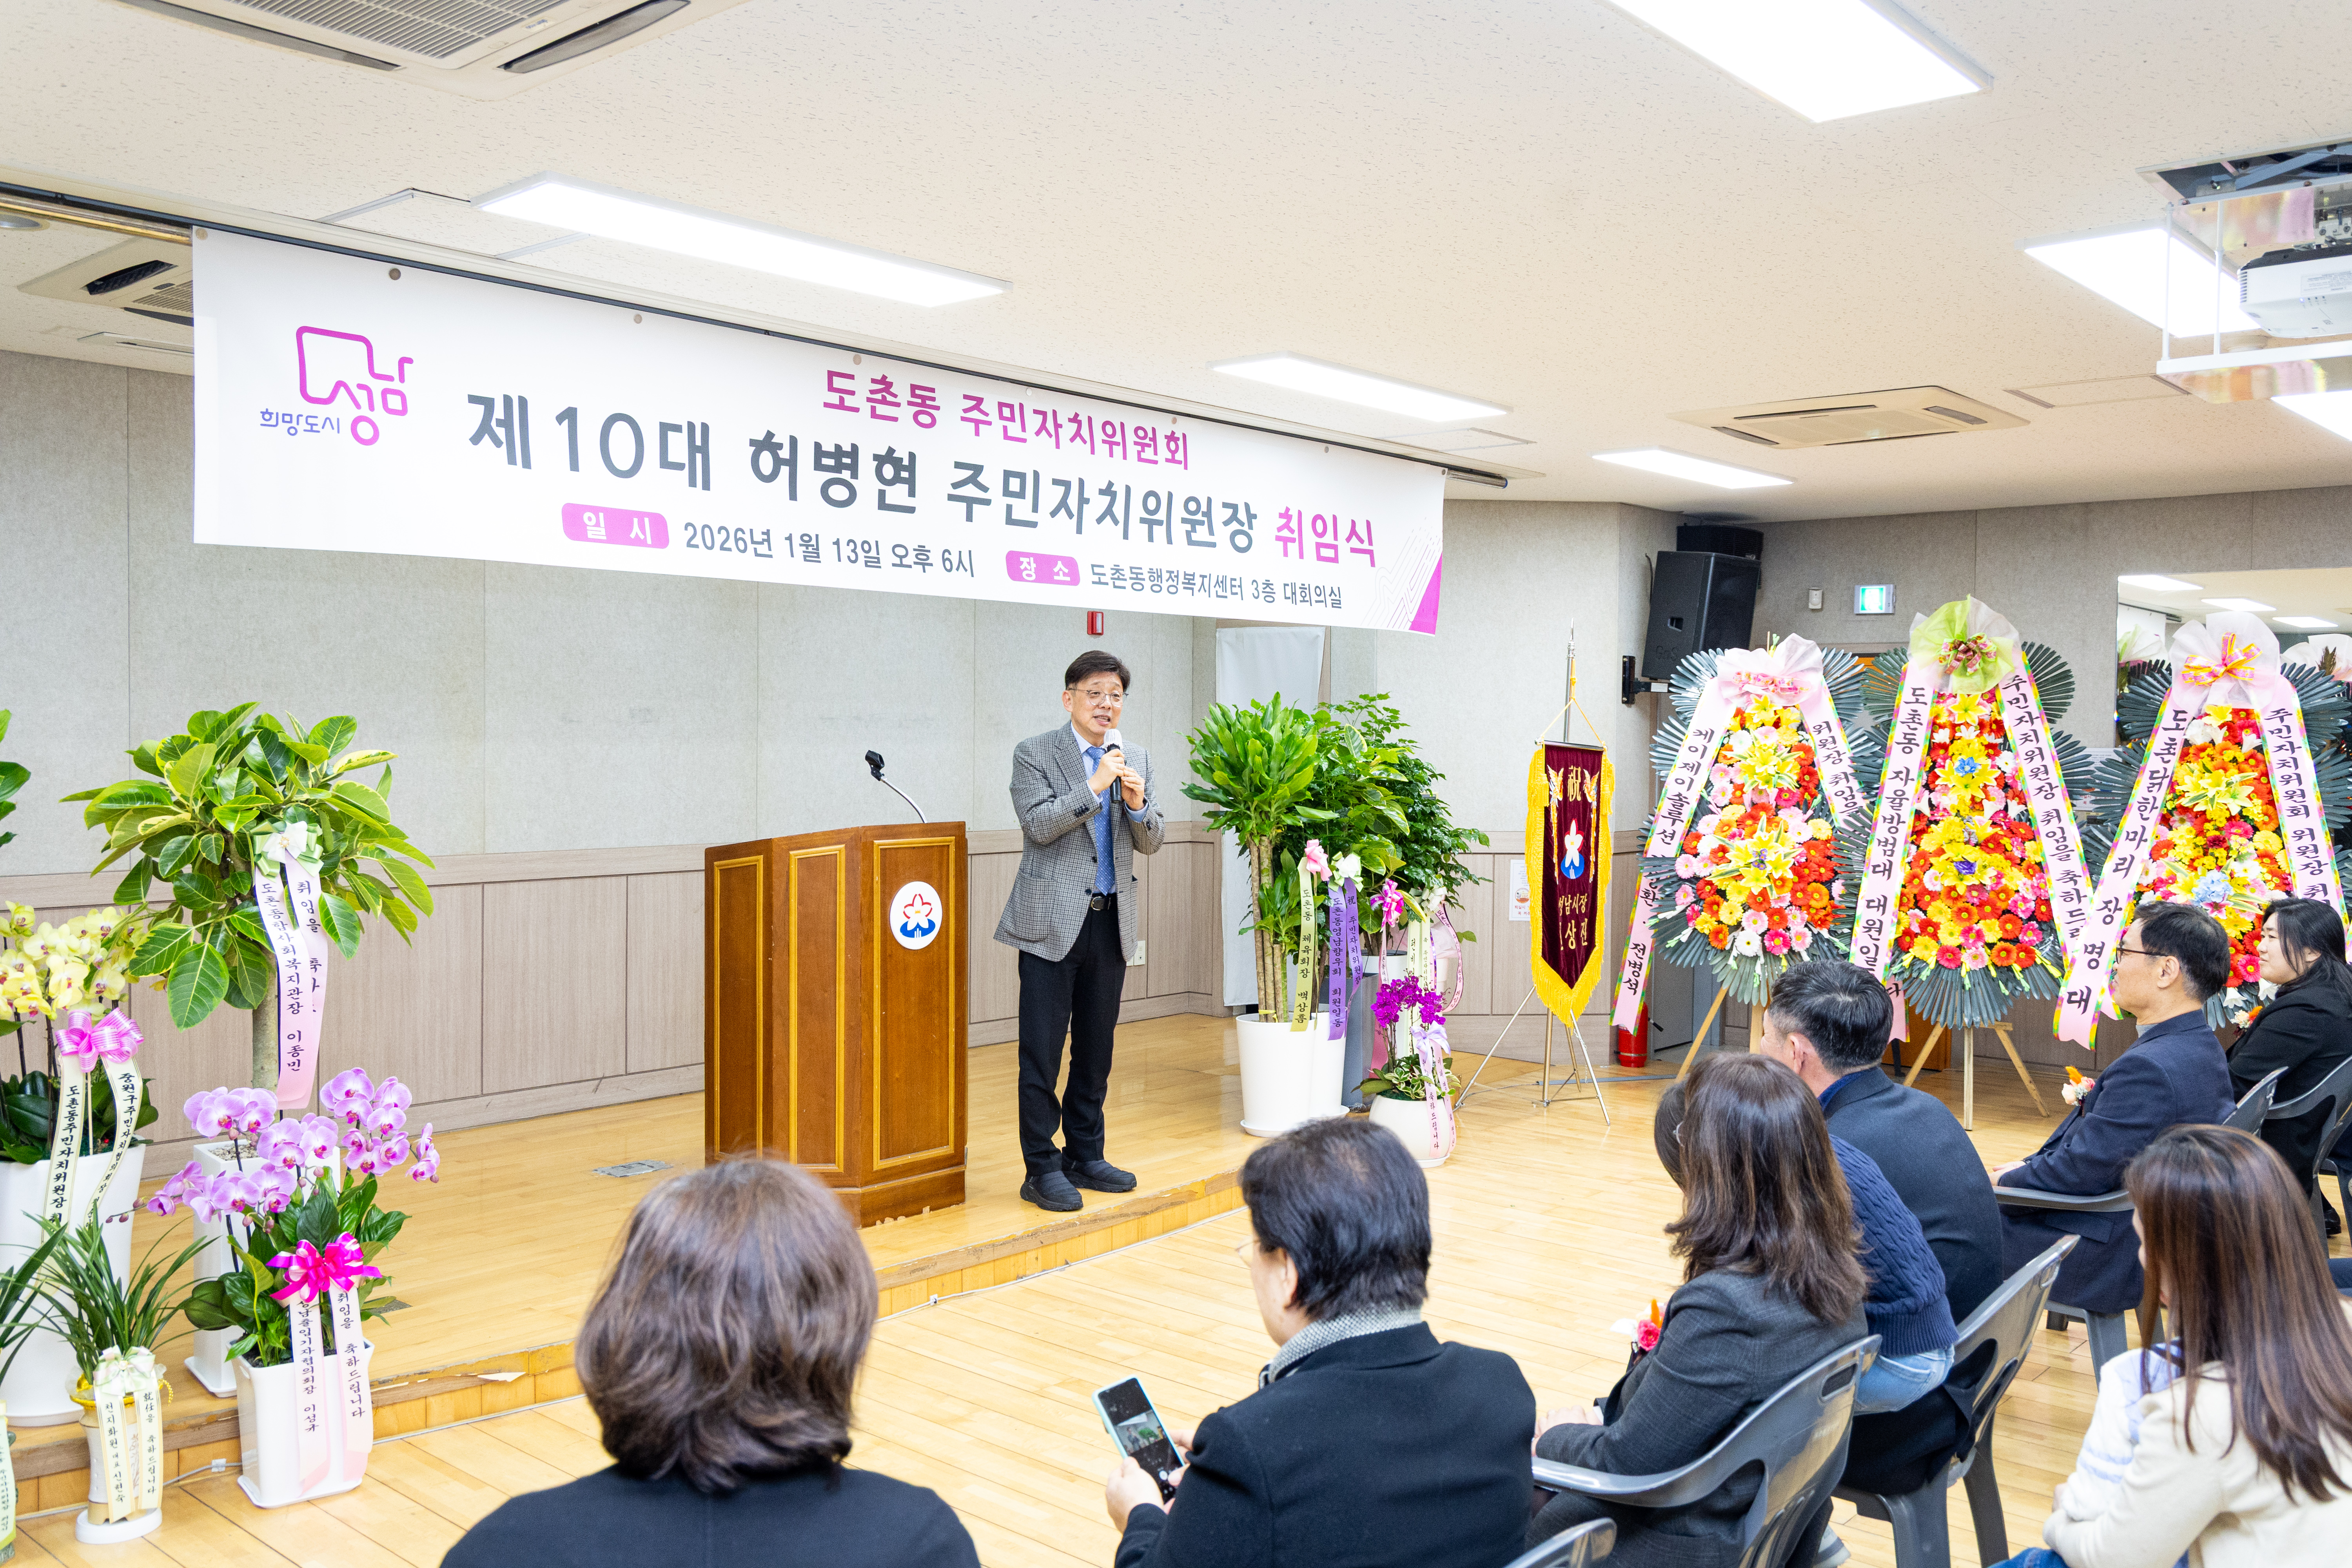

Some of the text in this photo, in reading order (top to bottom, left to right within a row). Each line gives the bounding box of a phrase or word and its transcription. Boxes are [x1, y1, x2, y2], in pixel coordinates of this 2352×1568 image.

[260, 408, 340, 436] 희망도시
[823, 368, 1188, 470] 도촌동 주민자치위원회
[467, 394, 1376, 568] 제10대 허병현 주민자치위원장 취임식
[684, 522, 975, 577] 2026년 1월 13일 오후 6시
[1091, 563, 1342, 609] 도촌동행정복지센터 3층 대회의실
[1813, 721, 1846, 765] 위원장
[1895, 687, 1928, 755] 도촌동
[1568, 765, 1581, 802] 祝
[1655, 728, 1715, 844] 케이제이솔루션
[2002, 675, 2058, 800] 주민자치위원장
[2040, 808, 2075, 862] 취임을
[2264, 707, 2310, 818] 주민자치위원회
[2291, 828, 2329, 875] 위원장
[1872, 766, 1915, 881] 자율방범대
[297, 880, 321, 933] 취임을
[1302, 889, 1313, 921] 도촌동
[1347, 895, 1356, 905] 祝
[261, 883, 305, 1072] 도촌종합사회복지관장 이종민
[1300, 934, 1312, 978] 체육회장
[1332, 897, 1343, 1028] 도촌동영남향우회 회원일동
[1348, 916, 1361, 985] 주민자치위원장
[1622, 942, 1648, 996] 전병석
[49, 1085, 80, 1209] 도촌동주민자치위원장
[97, 1072, 138, 1193] 중원구주민자치협의회장
[1429, 1092, 1439, 1151] 축하드립니다
[345, 1343, 365, 1418] 축하드립니다
[105, 1402, 118, 1449] 천지화원
[147, 1435, 157, 1494] 축하드립니다
